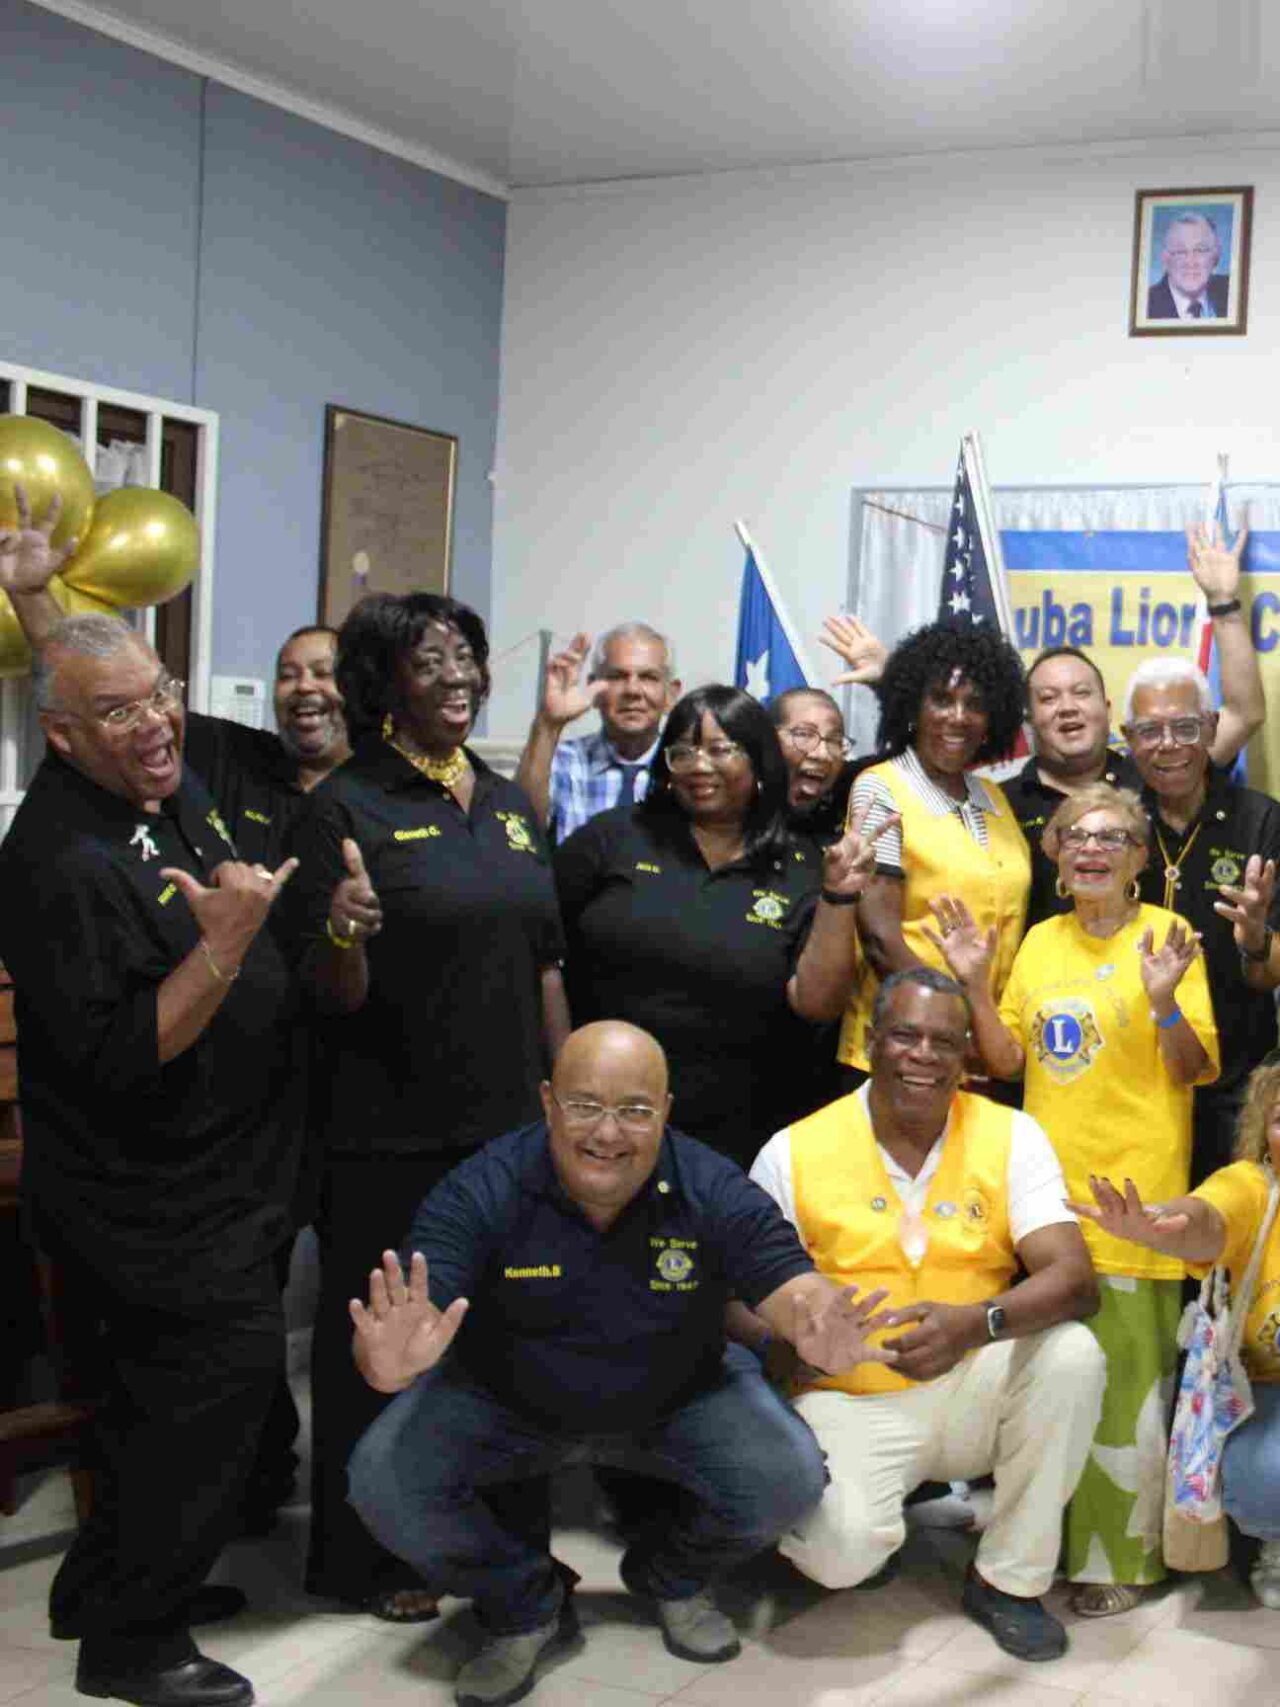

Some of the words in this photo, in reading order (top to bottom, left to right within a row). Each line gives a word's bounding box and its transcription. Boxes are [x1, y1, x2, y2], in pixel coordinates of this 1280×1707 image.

[1014, 589, 1093, 648] uba
[1110, 586, 1196, 647] Lion
[1051, 1018, 1075, 1053] L
